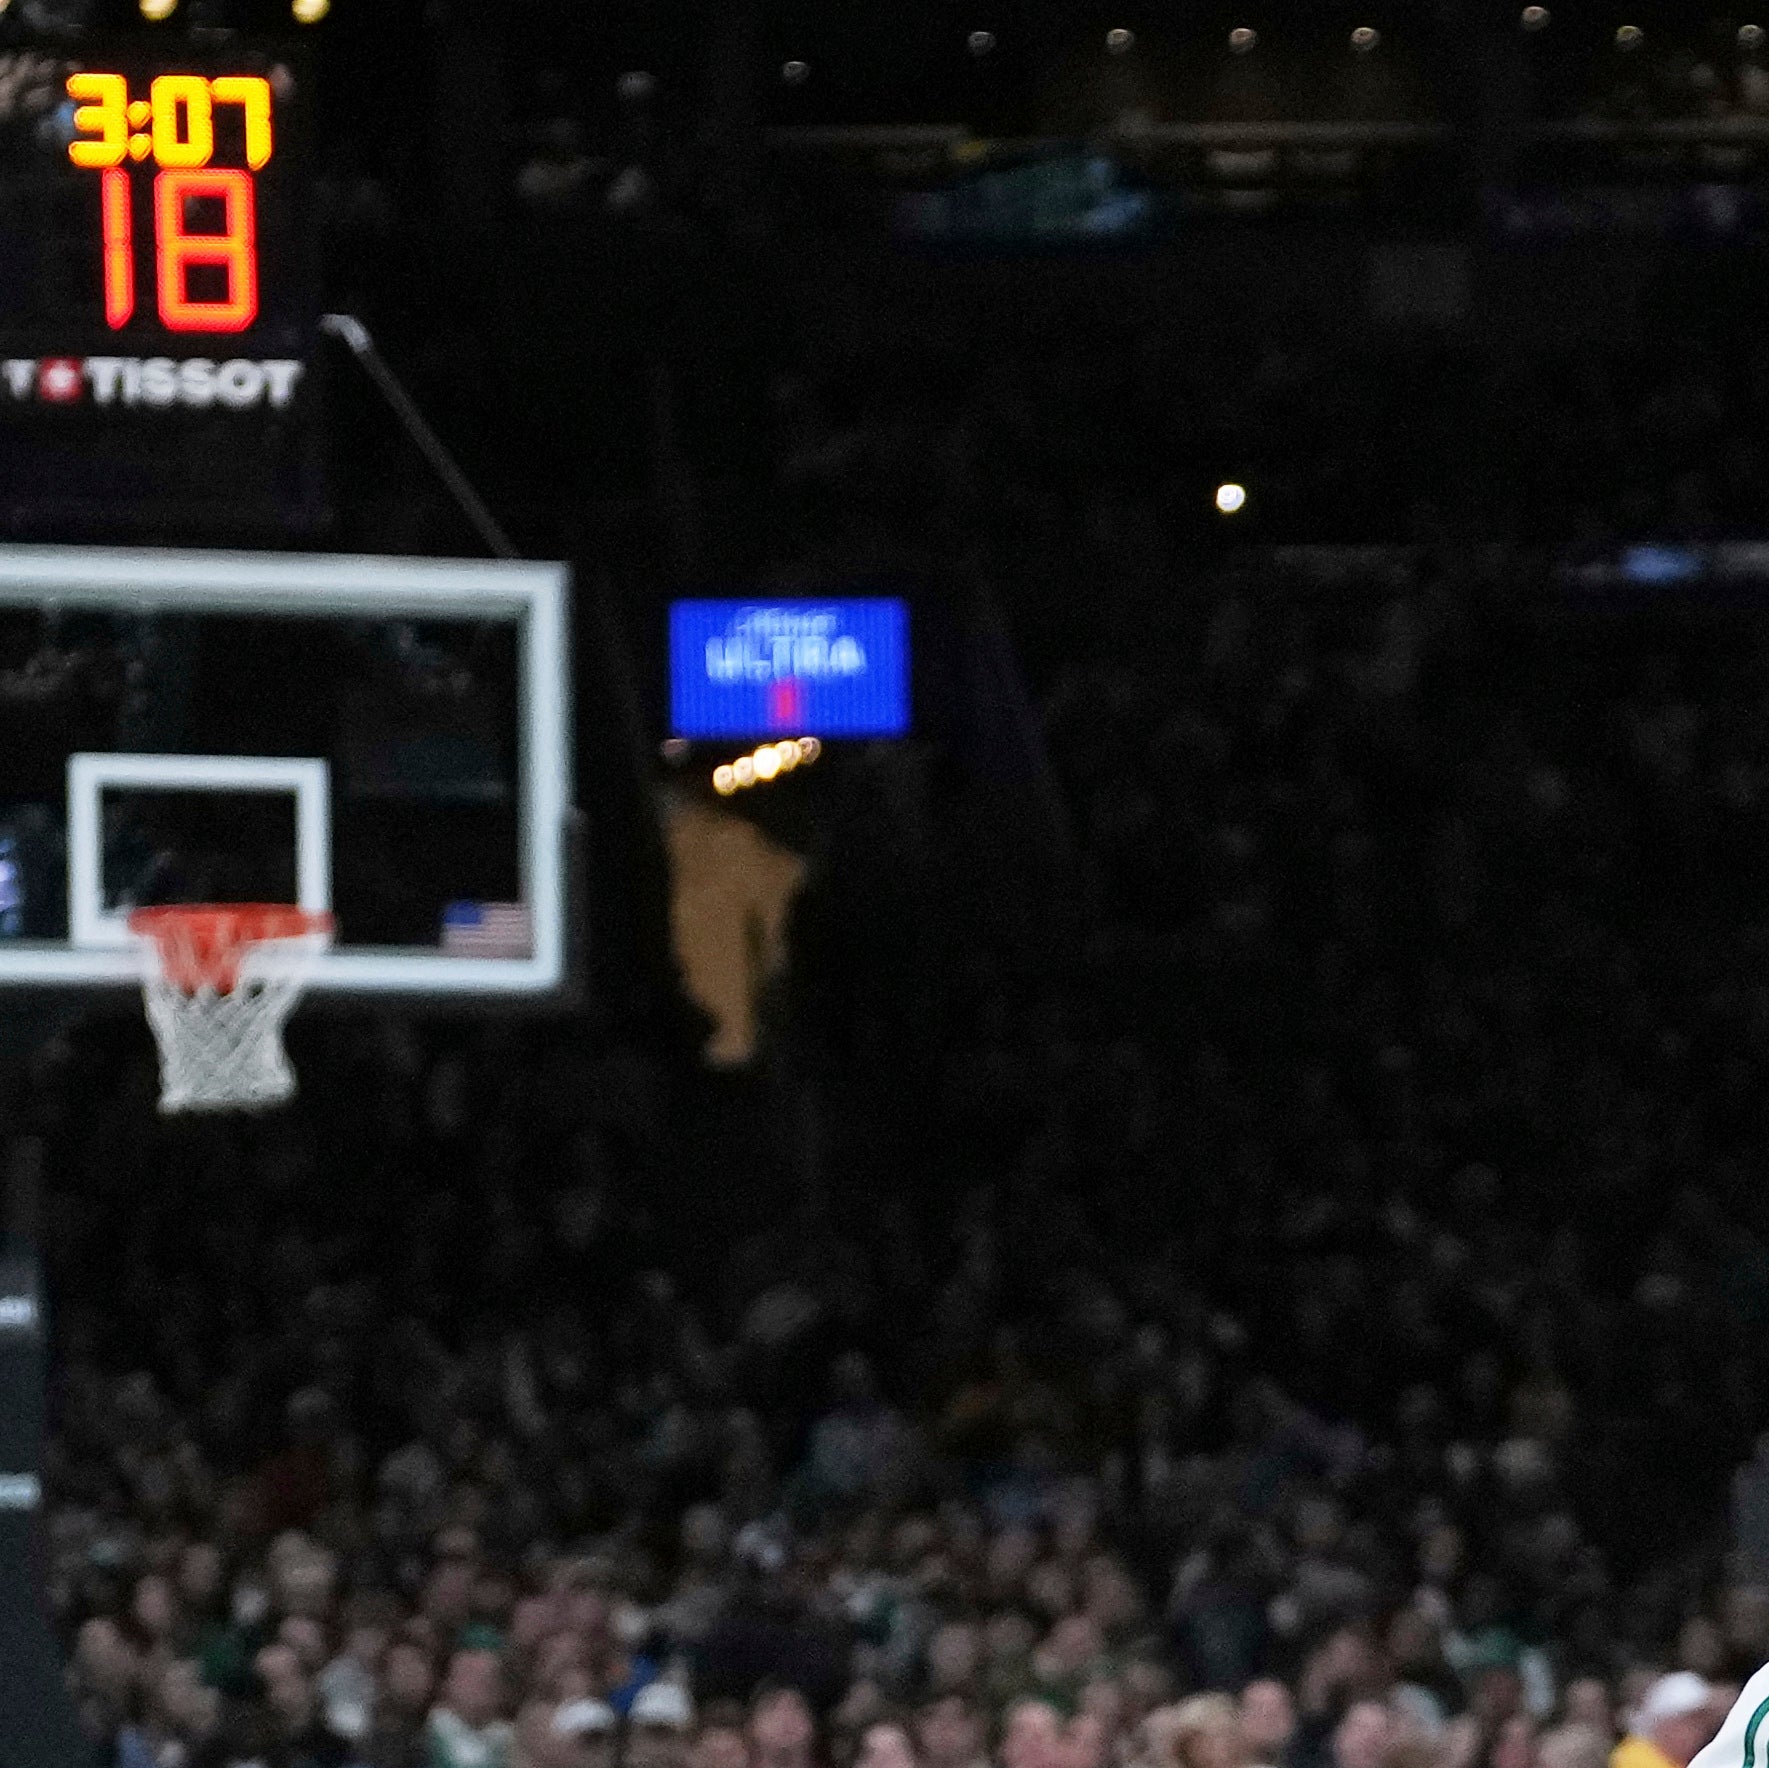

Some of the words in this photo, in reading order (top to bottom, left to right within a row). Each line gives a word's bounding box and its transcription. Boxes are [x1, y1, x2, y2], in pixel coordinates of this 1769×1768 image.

[66, 73, 273, 171] 3:07
[102, 168, 259, 332] 18
[84, 355, 304, 406] TISSOT
